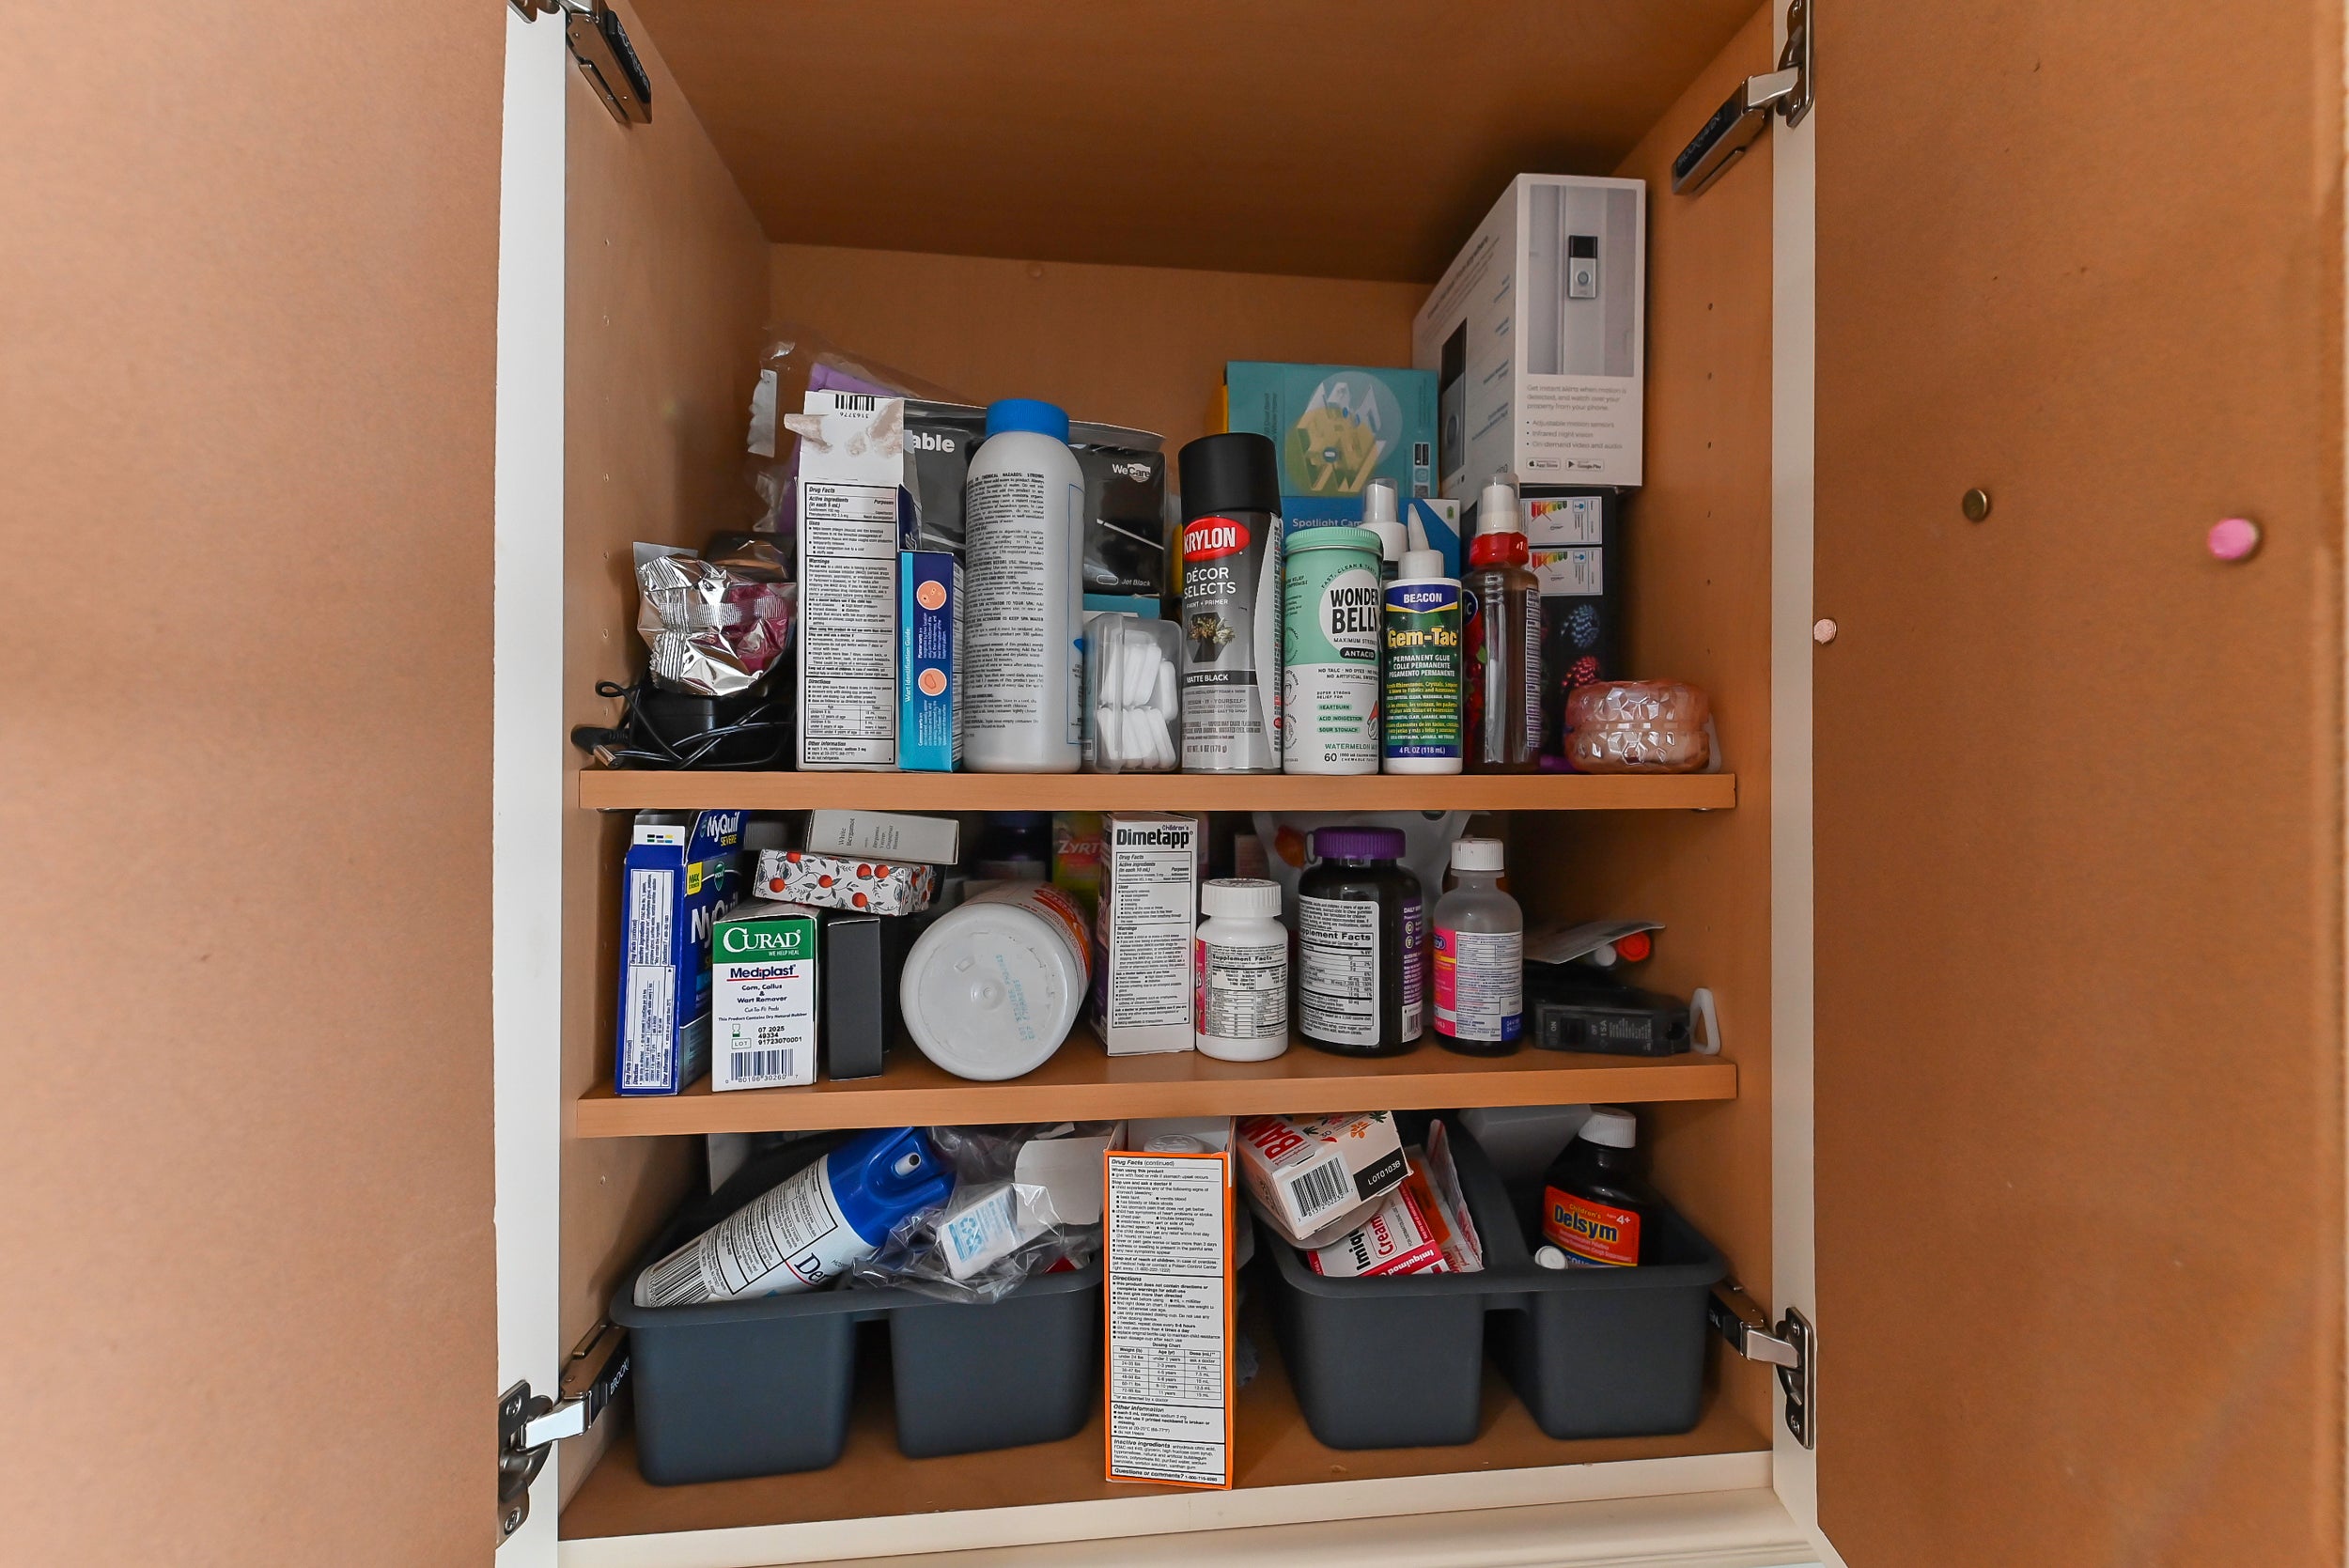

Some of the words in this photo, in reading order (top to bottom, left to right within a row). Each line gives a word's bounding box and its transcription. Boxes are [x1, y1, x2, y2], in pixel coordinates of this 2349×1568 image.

[1112, 464, 1151, 477] WeCare
[1184, 527, 1236, 554] KRYLON
[1186, 567, 1229, 583] DÉCOR
[1184, 582, 1237, 599] SELECTS
[1403, 593, 1442, 603] BEACON
[1388, 628, 1457, 648] Gem-Tac
[1205, 674, 1228, 682] BLACK
[1324, 753, 1337, 762] 60
[707, 812, 740, 842] NyQuil
[1116, 829, 1189, 848] Dimetapp
[689, 873, 700, 884] MAX
[723, 927, 801, 953] CURAD
[730, 965, 794, 979] Mediplast
[758, 1036, 802, 1045] 91723070001
[738, 1075, 760, 1083] 80196
[1569, 1203, 1602, 1219] Children's
[1554, 1204, 1618, 1242] Delsym
[1616, 1214, 1631, 1225] 4+
[1370, 1215, 1394, 1256] Cream
[1387, 1250, 1435, 1276] Imiquimod
